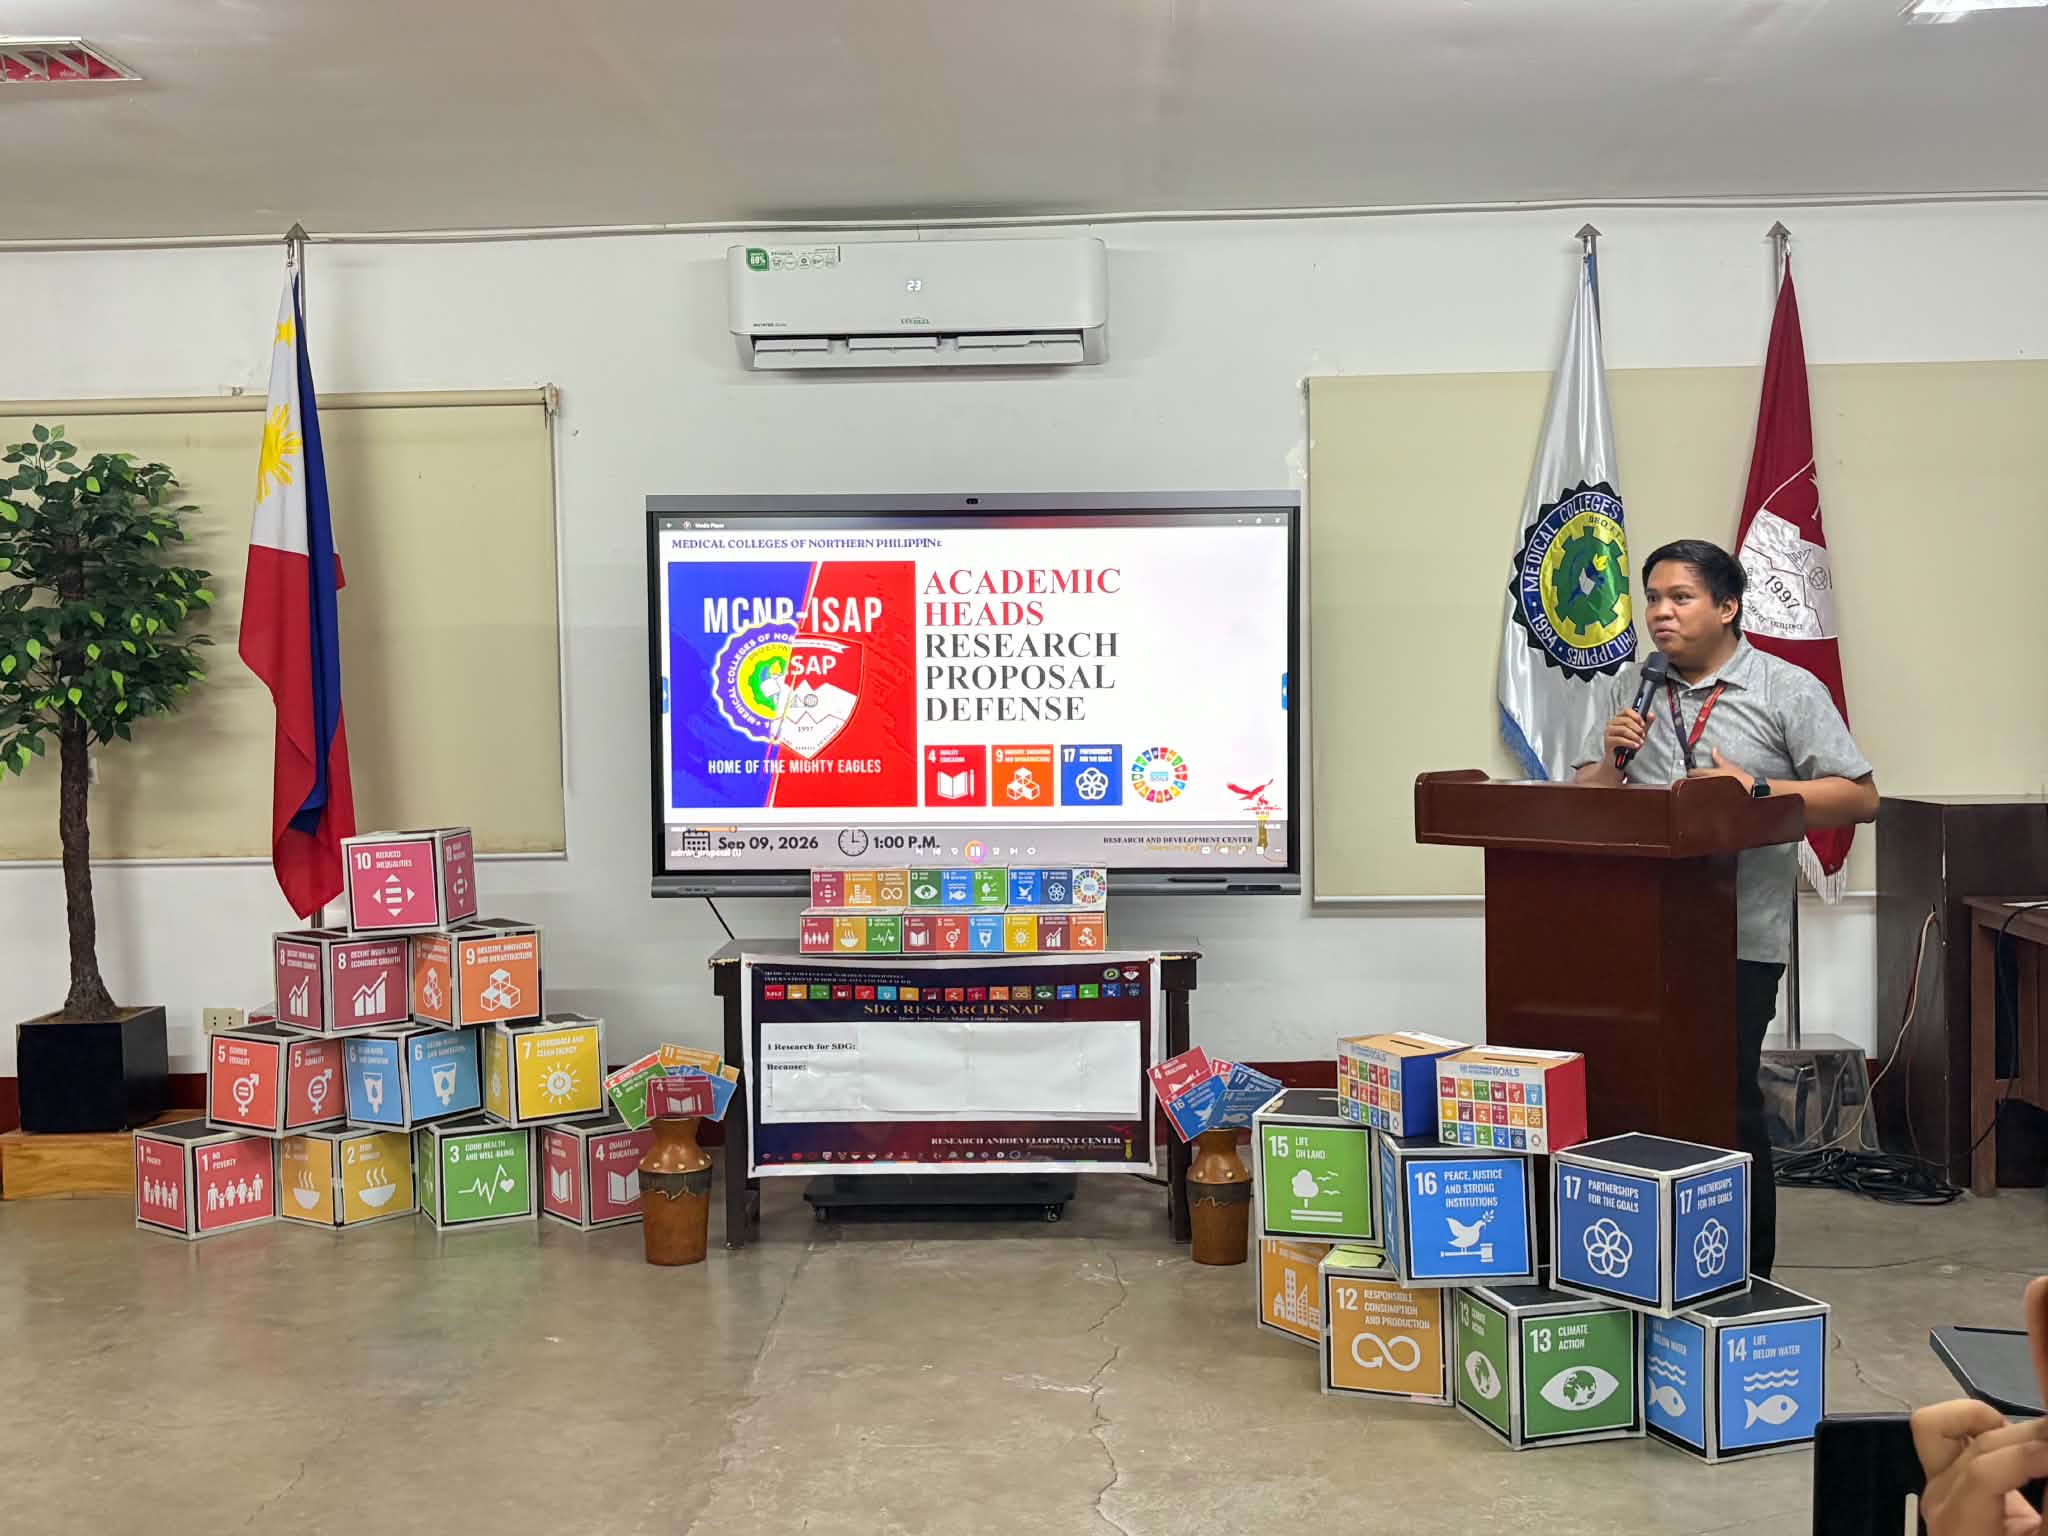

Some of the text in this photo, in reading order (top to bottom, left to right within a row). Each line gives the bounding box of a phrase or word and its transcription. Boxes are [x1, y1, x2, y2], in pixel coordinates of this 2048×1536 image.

[907, 280, 921, 291] 23
[672, 538, 725, 549] MEDICAL
[728, 538, 788, 549] COLLEGES
[791, 538, 807, 549] OF
[809, 538, 874, 548] NORTHERN
[1524, 522, 1559, 592] MEDICAL
[1559, 495, 1620, 523] COLLEGES
[923, 568, 1121, 594] ACADEMIC
[1765, 575, 1800, 609] 1997
[703, 597, 883, 634] MCNP-ISAP
[924, 601, 1044, 626] HEADS
[758, 634, 770, 642] OF
[1532, 613, 1558, 649] 1994
[925, 632, 1120, 658] RESEARCH
[925, 664, 1116, 690] PROPOSAL
[924, 696, 1086, 722] DEFENSE
[928, 750, 936, 762] 4
[996, 750, 1004, 762] 9
[1064, 749, 1075, 762] 17
[708, 760, 881, 774] HOME OF THE MIGHTY EAGLES
[750, 836, 773, 851] 09,
[778, 836, 818, 849] 2026
[873, 836, 940, 849] 1:00 P.M.
[355, 853, 372, 870] 10
[338, 952, 346, 969] 8
[466, 948, 475, 965] 9
[1000, 1004, 1044, 1014] SNAP
[218, 1045, 226, 1063] 5
[415, 1044, 423, 1061] 6
[523, 1041, 531, 1059] 7
[774, 1043, 814, 1051] Research
[832, 1042, 856, 1050] SDG:
[1154, 1068, 1162, 1079] 4
[1492, 1065, 1520, 1077] GOALS
[614, 1087, 623, 1098] 3
[464, 1143, 482, 1151] GOOD
[1268, 1135, 1289, 1158] 15
[1295, 1136, 1308, 1146] LIFE
[140, 1145, 145, 1162] 1
[346, 1147, 356, 1164] 2
[450, 1146, 460, 1163] 3
[465, 1152, 478, 1161] AND
[595, 1144, 605, 1160] 4
[1296, 1149, 1326, 1160] ON LAND
[201, 1154, 209, 1172] 1
[212, 1158, 236, 1170] POVERTY
[1443, 1169, 1503, 1181] PEACE, JUSTICE
[1415, 1172, 1438, 1196] 16
[1445, 1183, 1495, 1194] AND STRONG
[1563, 1175, 1582, 1200] 17
[1588, 1180, 1639, 1199] PARTNERSHIPS
[1698, 1178, 1733, 1195] PARTNERSHIPS
[1446, 1197, 1498, 1208] INSTITUTIONS
[1588, 1194, 1639, 1213] FOR THE GOALS
[1679, 1189, 1693, 1215] 17
[1698, 1193, 1733, 1211] FOR THE GOALS
[1336, 1287, 1359, 1311] 12
[1363, 1289, 1413, 1303] RESPONSIBLE
[1364, 1302, 1418, 1315] CONSUMPTION
[1459, 1302, 1470, 1326] 13
[1365, 1316, 1430, 1329] AND PRODUCTION
[1558, 1325, 1588, 1337] CLIMATE
[1530, 1329, 1551, 1352] 13
[1558, 1338, 1585, 1351] ACTION
[1753, 1335, 1767, 1345] LIFE
[1727, 1336, 1747, 1363] 14
[1753, 1345, 1800, 1360] BELOW WATER
